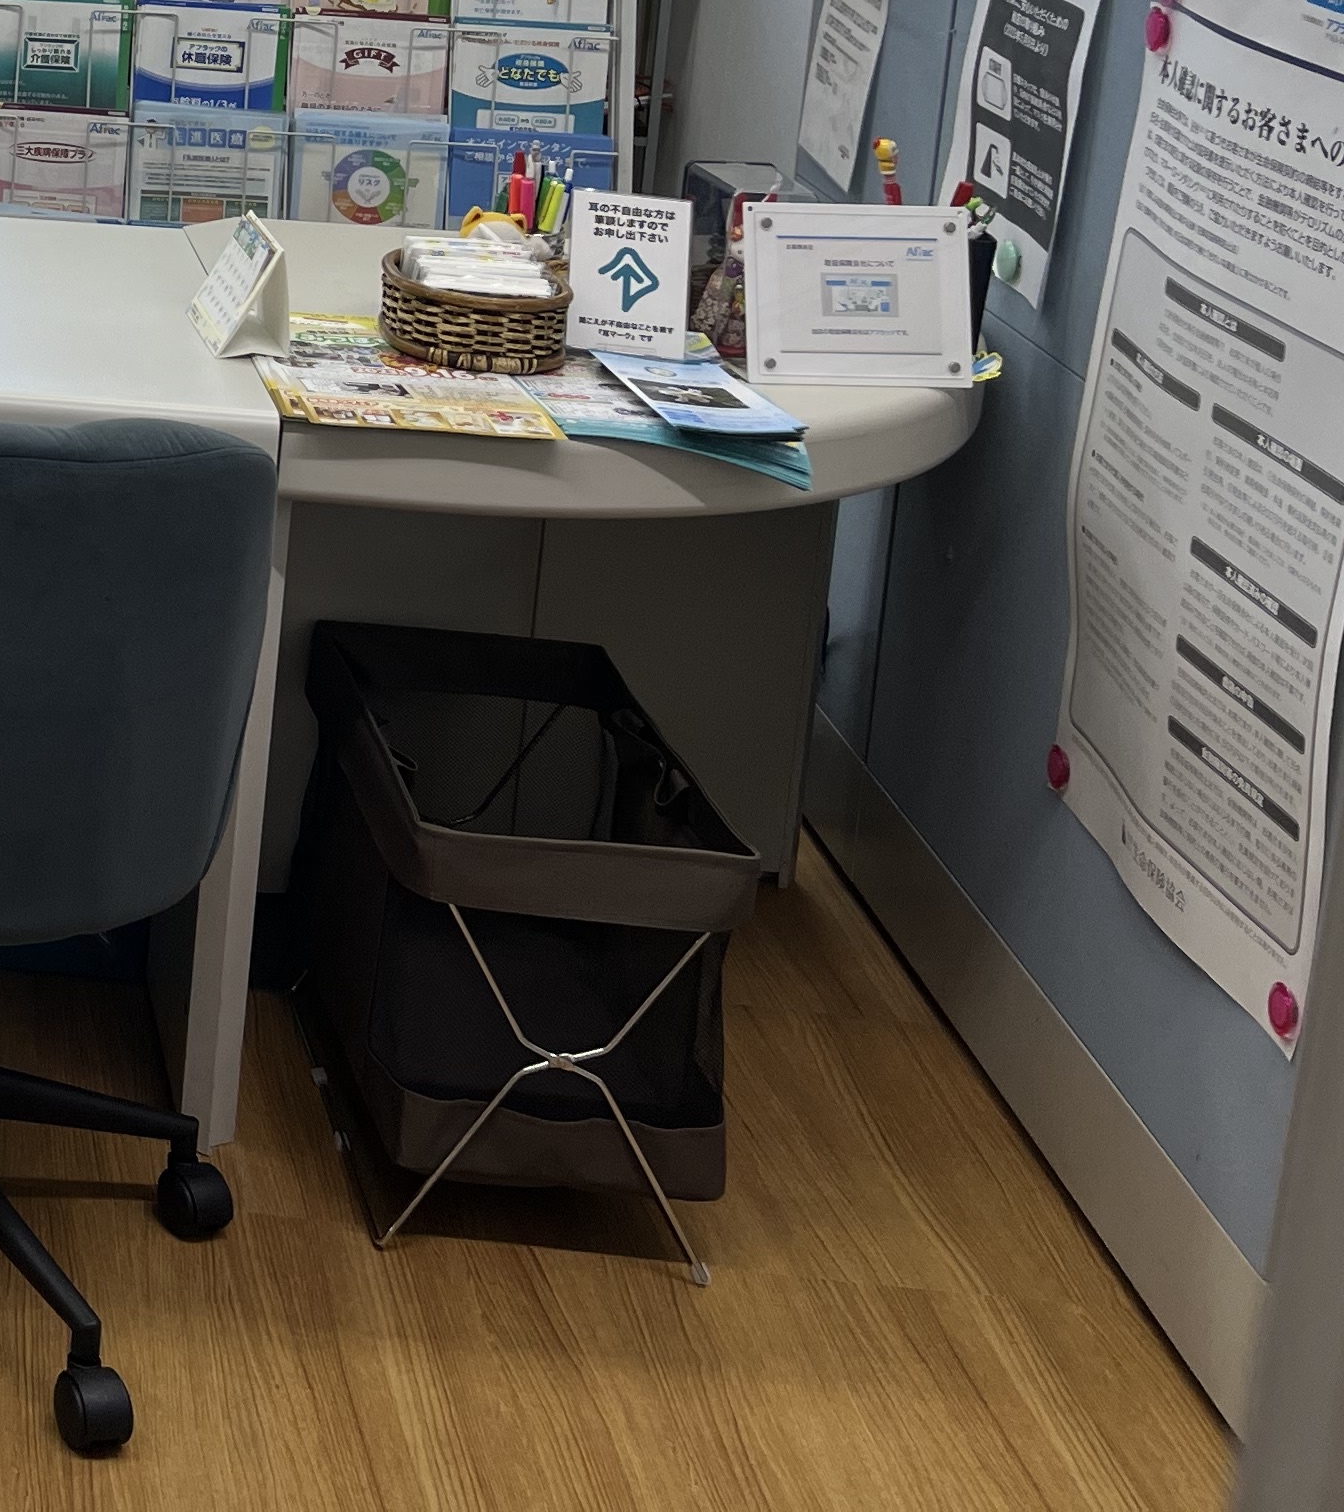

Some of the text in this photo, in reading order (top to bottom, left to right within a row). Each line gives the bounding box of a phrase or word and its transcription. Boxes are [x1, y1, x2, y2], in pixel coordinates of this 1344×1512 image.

[188, 44, 227, 52] アフラックの
[354, 49, 386, 60] GIFT
[30, 54, 71, 65] 介護保険
[181, 52, 232, 66] 休職保険
[498, 68, 561, 82] どなたでも
[90, 123, 120, 135] Aflac
[168, 129, 245, 147] 先進医療
[358, 178, 380, 186] リスク
[588, 200, 676, 221] 耳の不自由な方は
[594, 215, 669, 232] 筆談しますので
[593, 227, 668, 244] お申し出下さい
[905, 247, 934, 258] Aflac
[578, 315, 674, 334] 聞こえが不自由なことを表す
[597, 329, 653, 343] 『耳マーク』です
